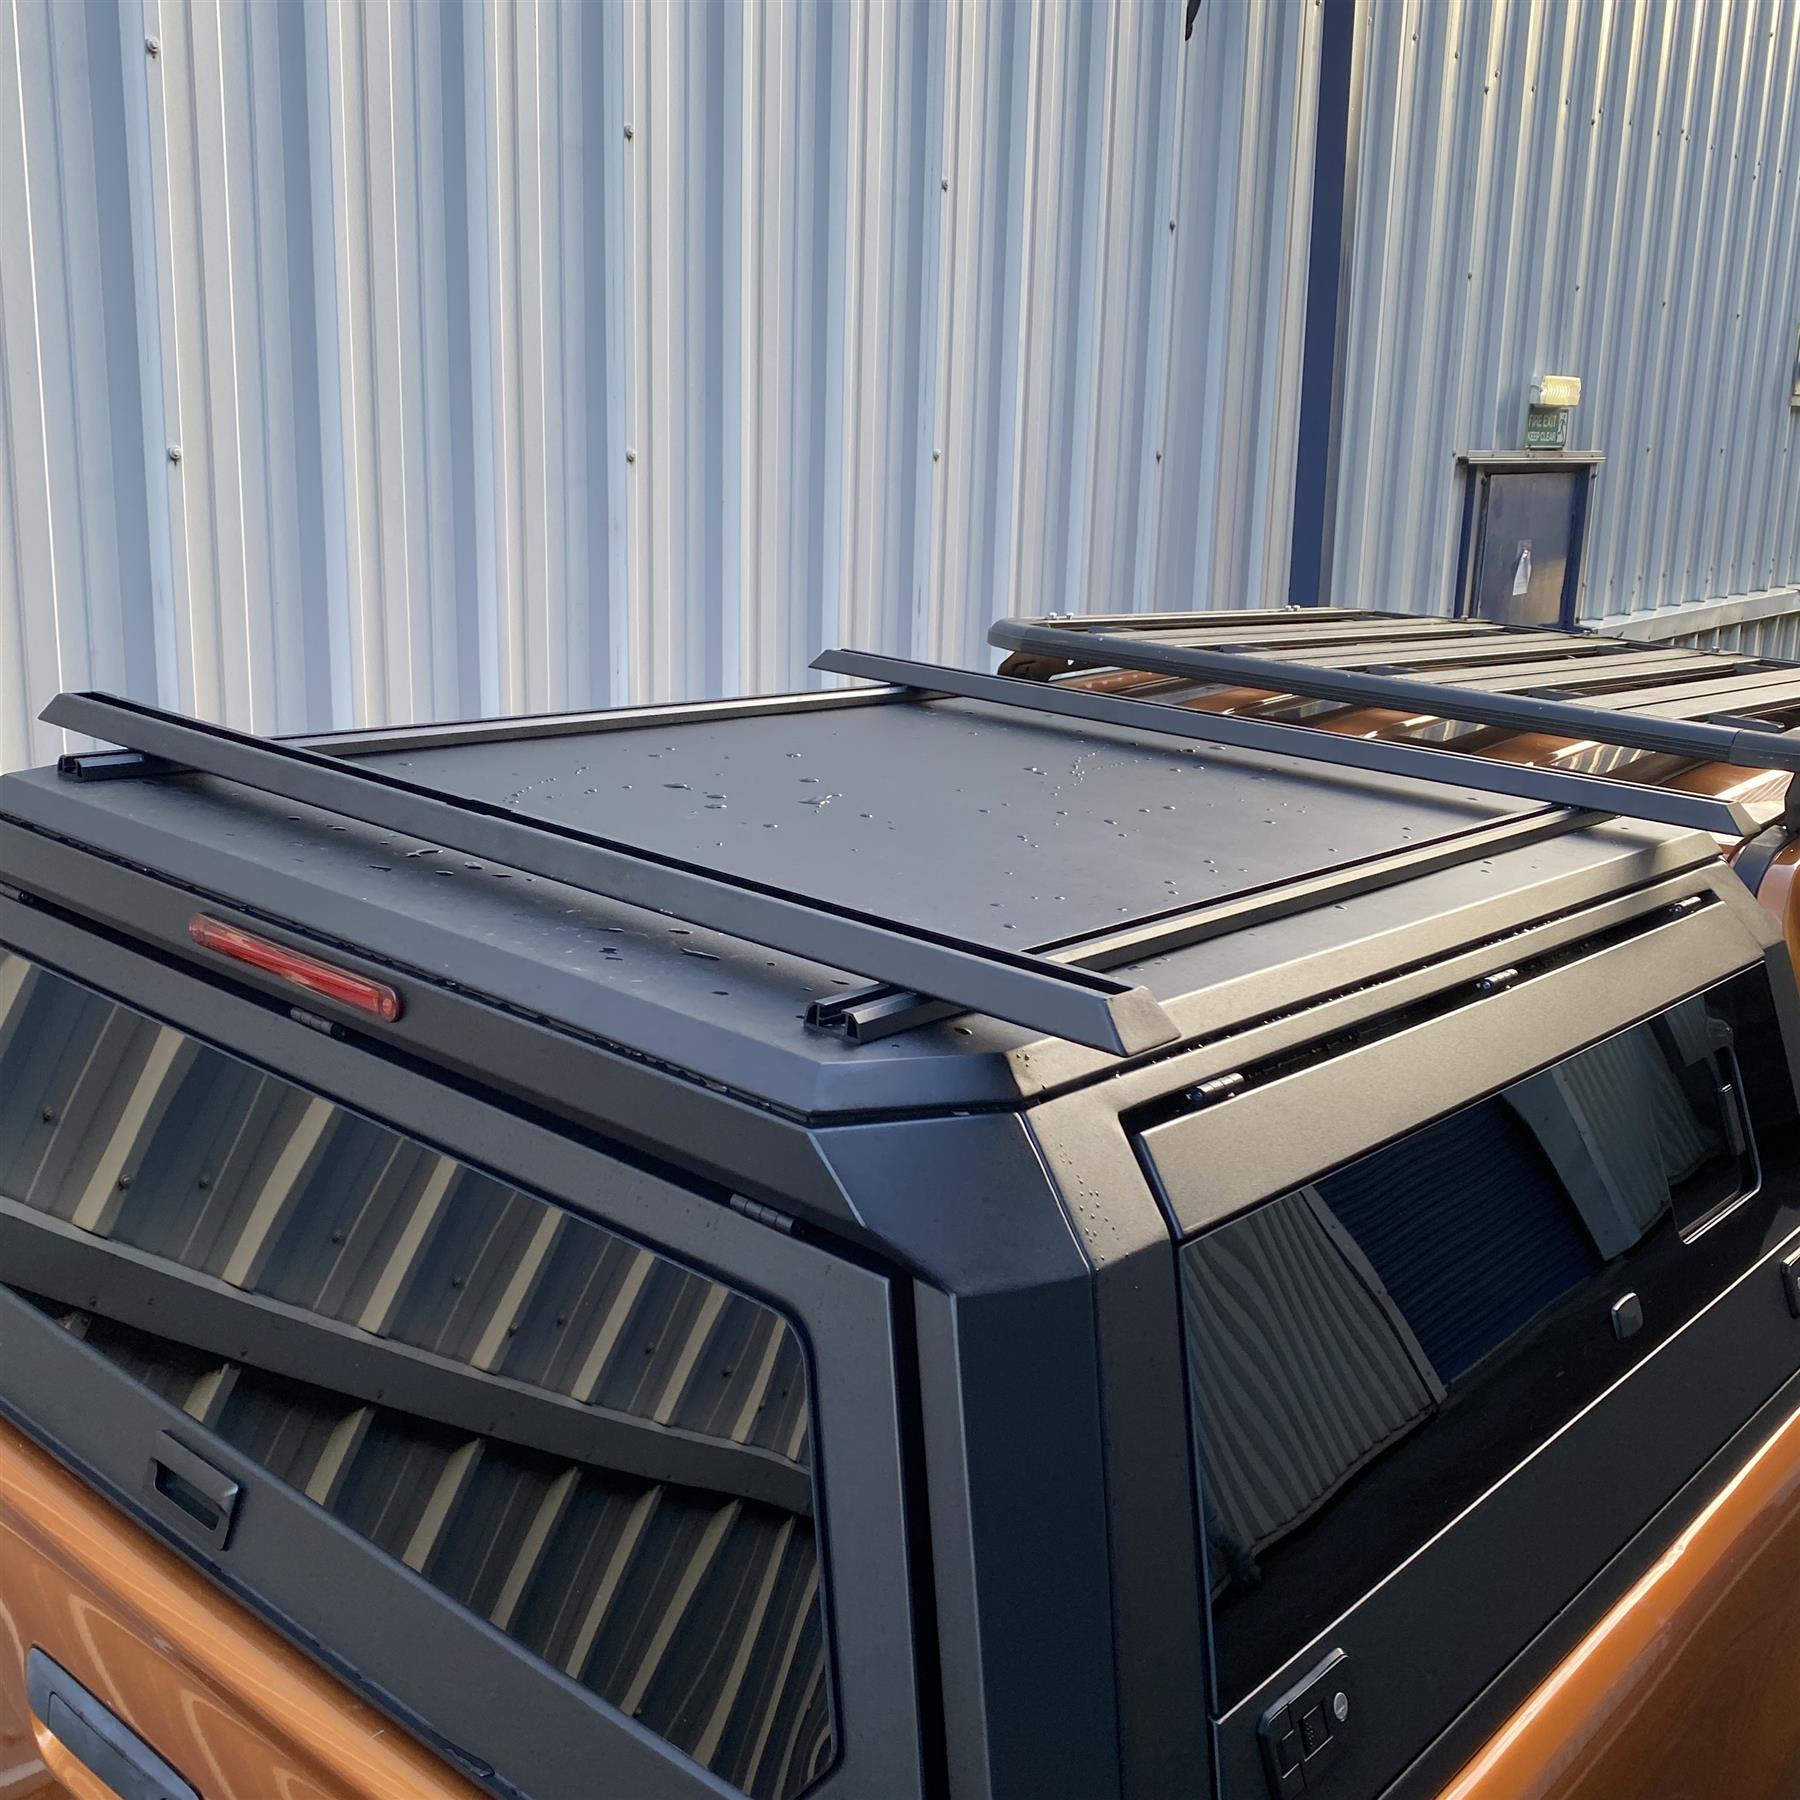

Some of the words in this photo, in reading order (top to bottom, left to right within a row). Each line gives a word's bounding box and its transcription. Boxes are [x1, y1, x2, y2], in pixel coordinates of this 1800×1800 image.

[1528, 414, 1543, 427] FIRE
[1543, 414, 1557, 427] EXIT
[1527, 431, 1540, 442] KEEP
[1540, 431, 1556, 442] CLEAR
